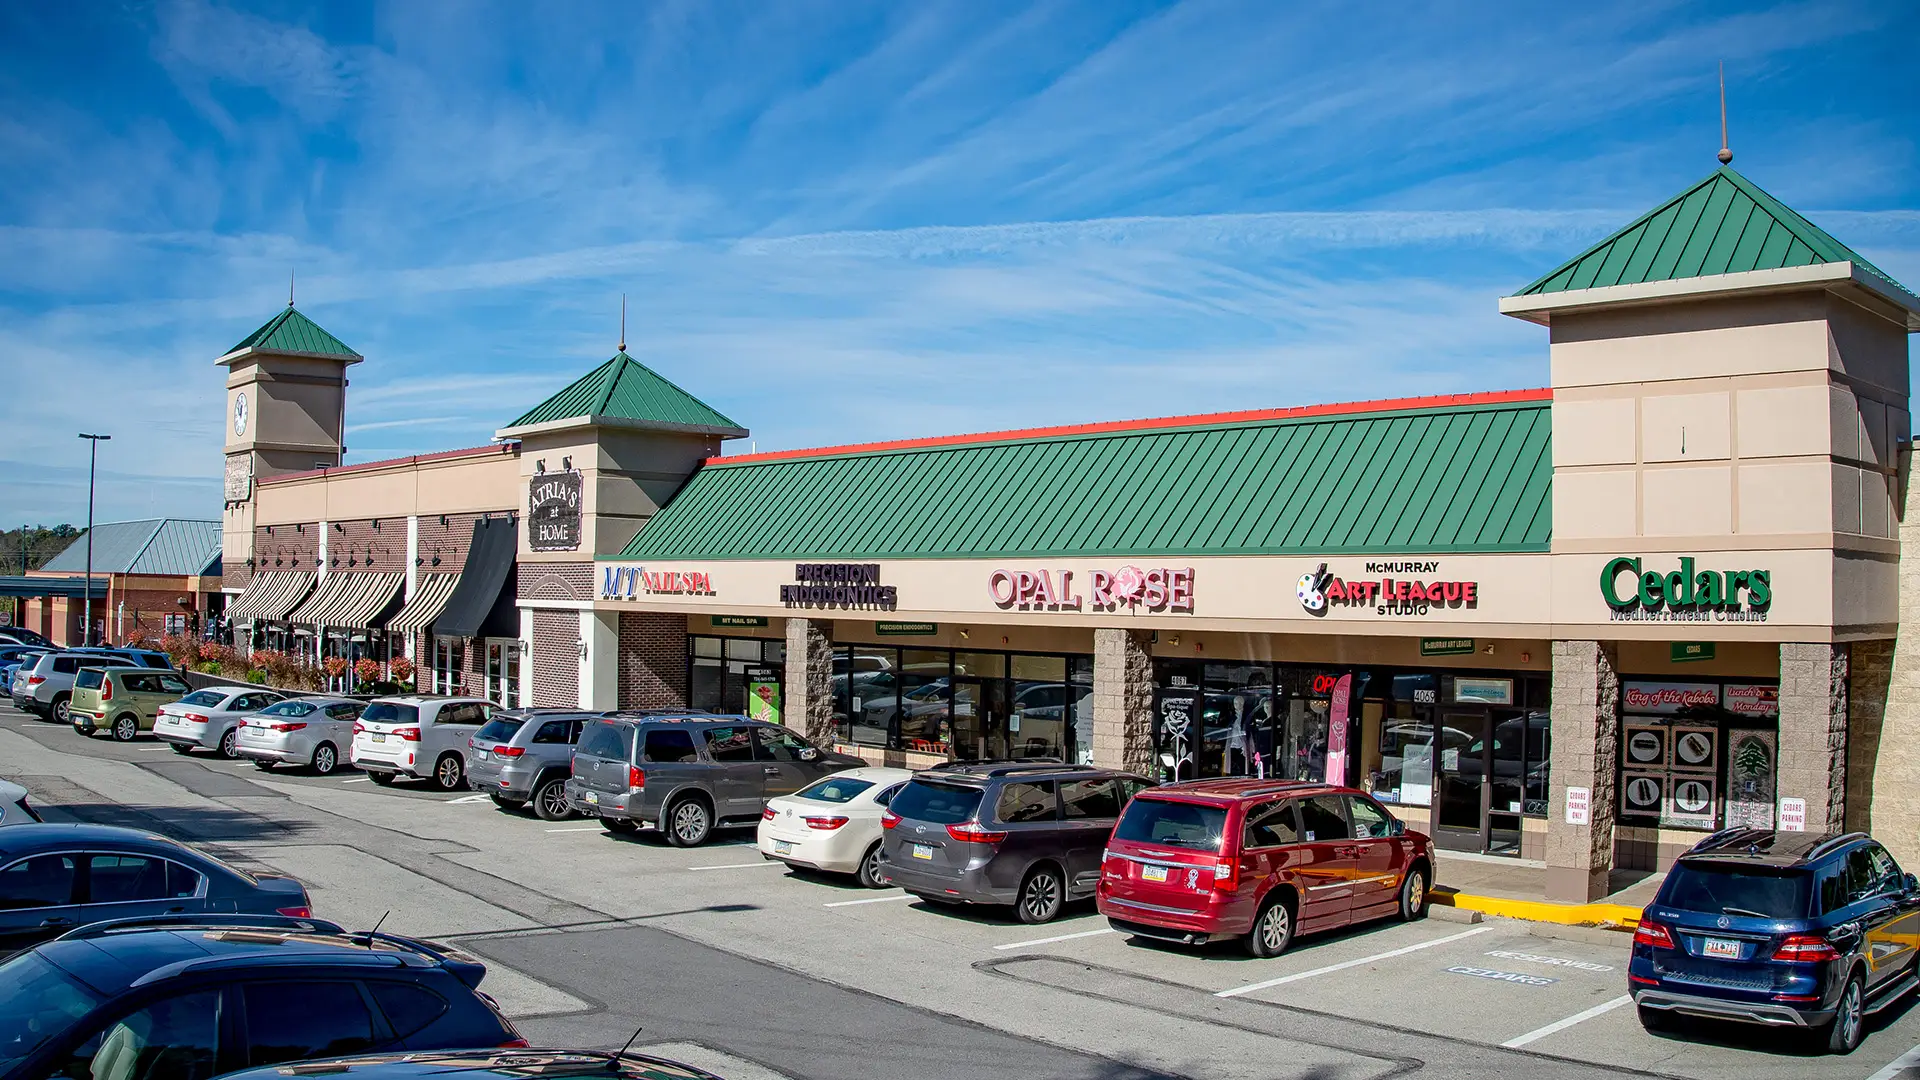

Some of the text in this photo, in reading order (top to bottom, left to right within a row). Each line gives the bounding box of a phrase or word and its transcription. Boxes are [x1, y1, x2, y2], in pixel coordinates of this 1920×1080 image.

[532, 481, 577, 513] ATRIA'S
[550, 506, 559, 518] at
[539, 524, 569, 541] HOME
[796, 563, 880, 582] PRECISION
[1365, 561, 1440, 573] McMURRAY
[600, 566, 712, 598] MT NAIL SPA
[988, 568, 1078, 607] OPAL
[1600, 556, 1772, 607] Cedars
[779, 584, 897, 605] ENDODONTICS
[1326, 578, 1477, 602] ART LEAGUE
[1377, 604, 1428, 616] STUDIO
[1610, 608, 1768, 622] Mediterranean Cuisine
[1414, 689, 1435, 703] 4069
[1625, 688, 1716, 707] King of the Kabobs
[1728, 685, 1755, 698] Lunch
[1732, 700, 1770, 714] Monday
[1570, 791, 1586, 800] CEDARS
[1568, 802, 1587, 810] PARKING
[1783, 803, 1802, 812] CEDARS
[1572, 811, 1583, 819] ONLY
[1781, 813, 1802, 823] PARKING
[1483, 950, 1615, 972] RESERVED
[1447, 966, 1553, 986] CEDARS
